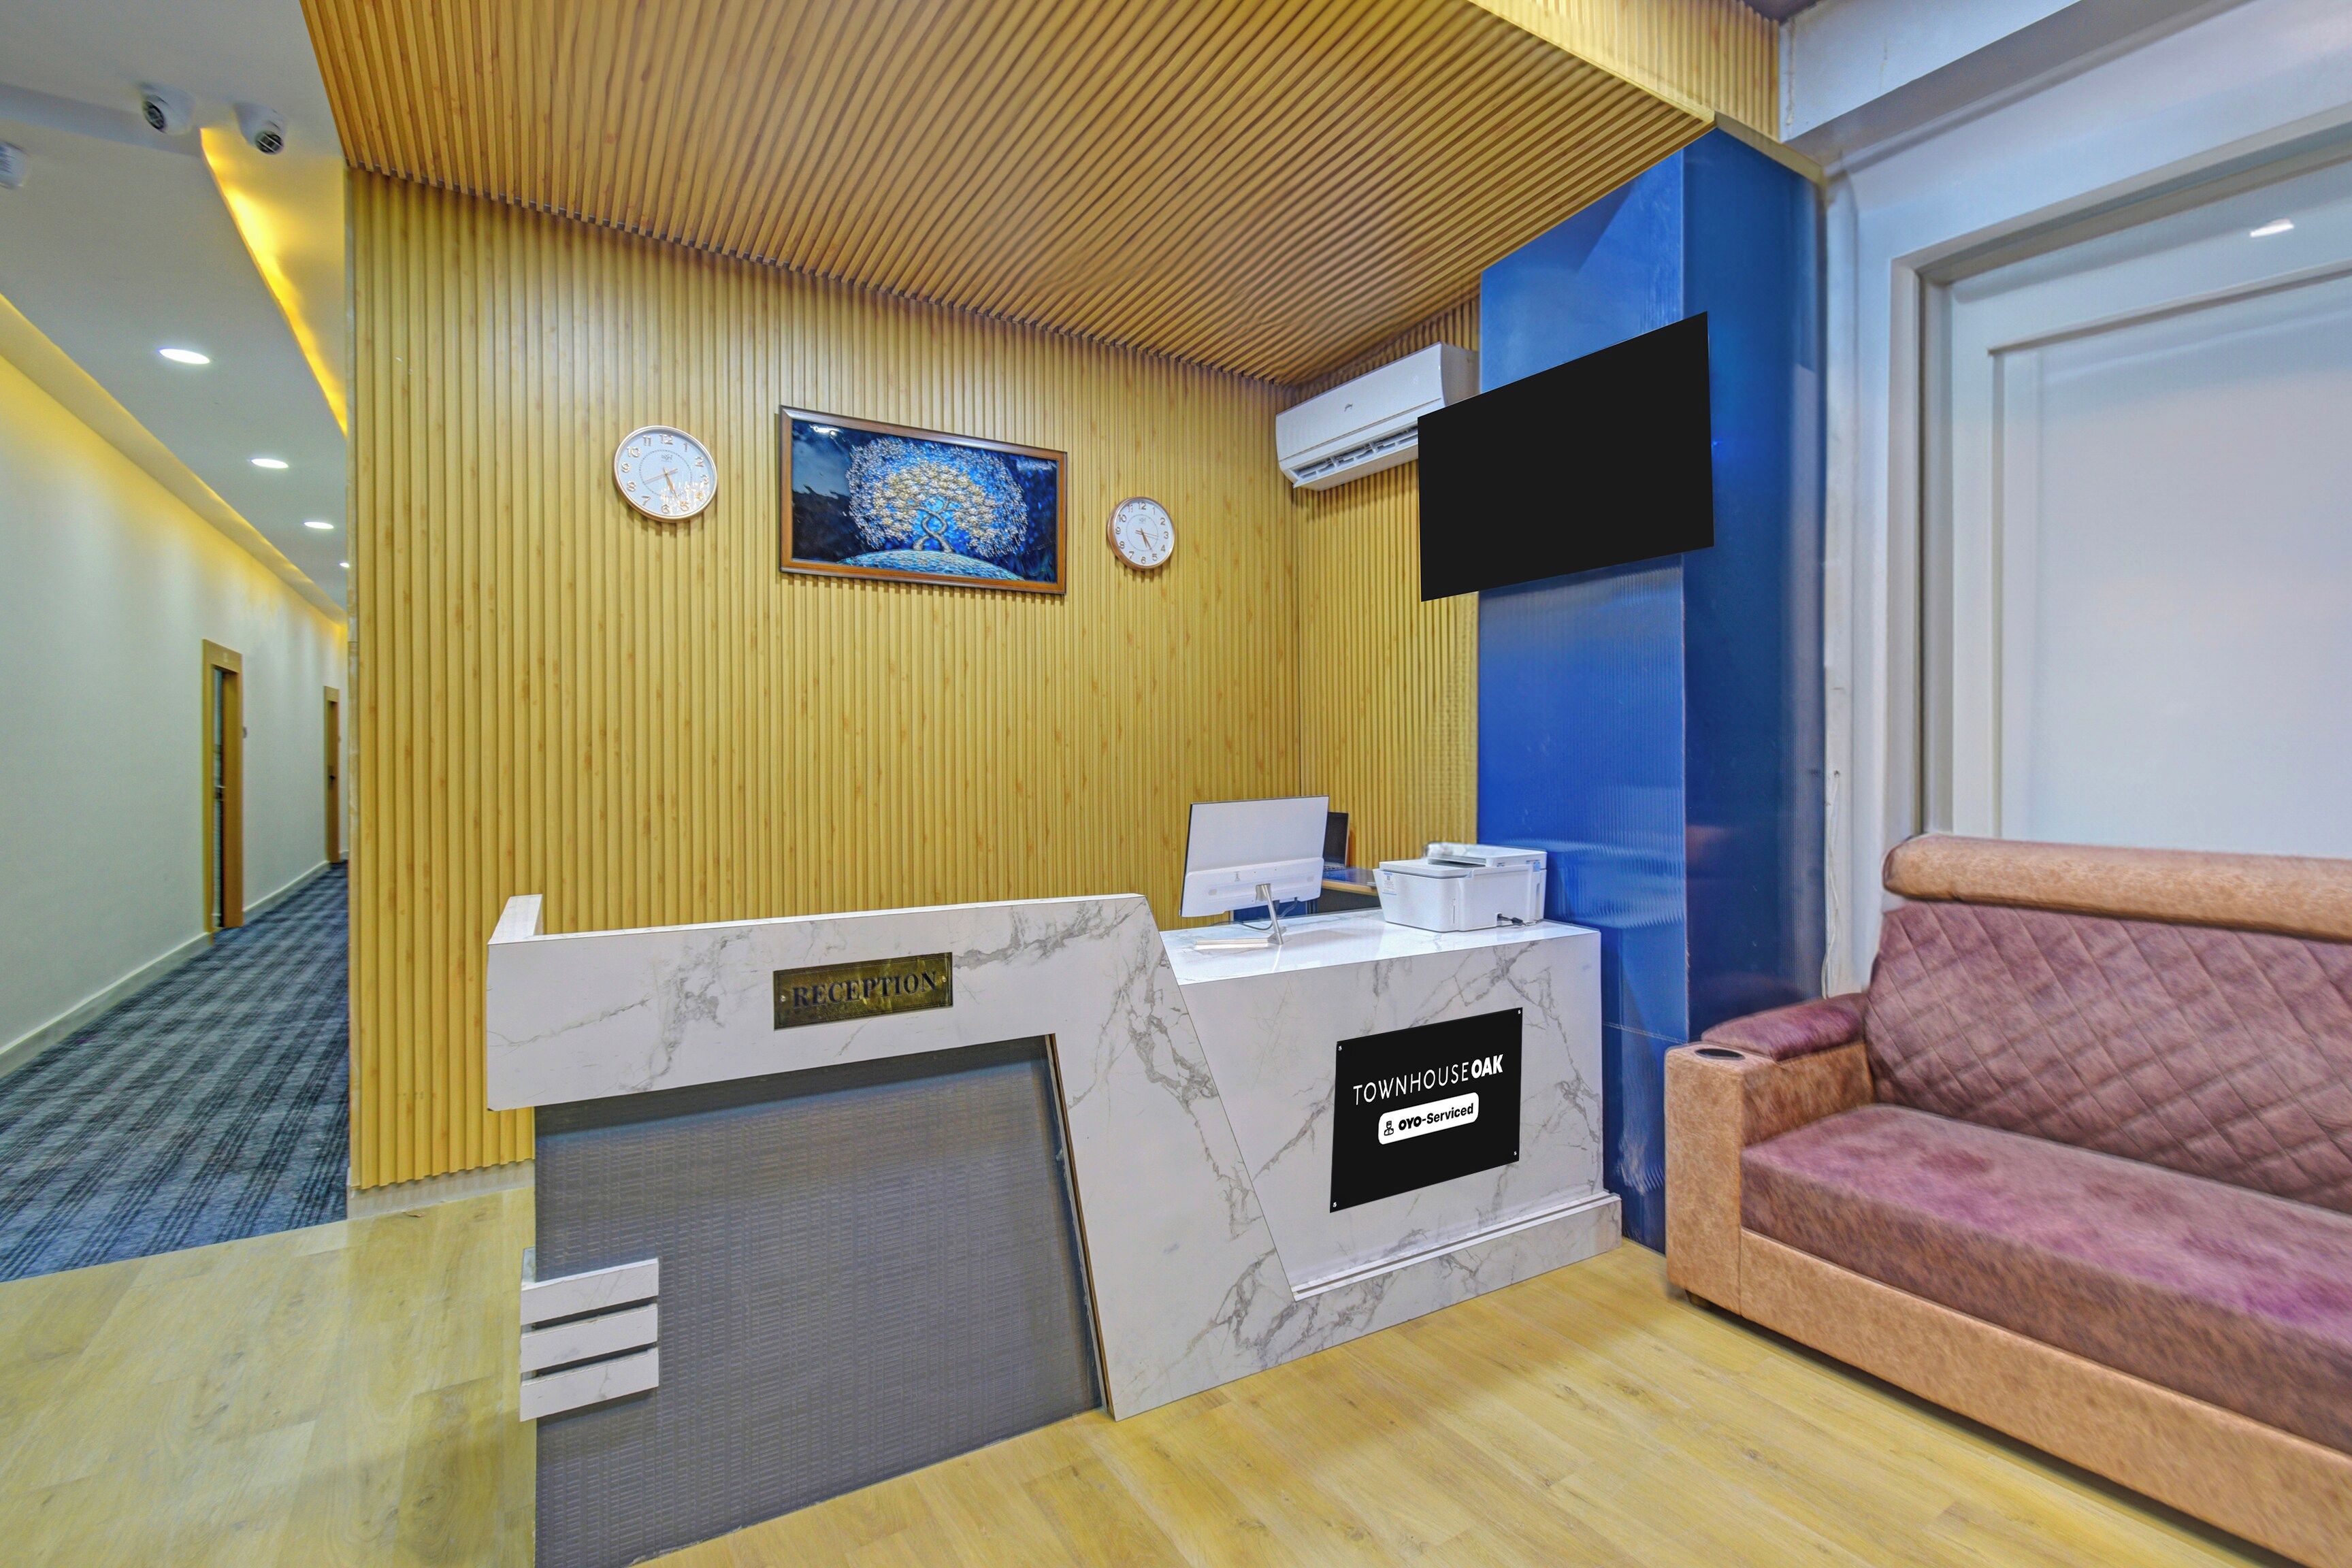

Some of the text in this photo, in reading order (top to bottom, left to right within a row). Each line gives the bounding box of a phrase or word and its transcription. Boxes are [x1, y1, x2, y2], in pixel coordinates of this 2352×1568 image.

[642, 435, 651, 446] 11
[659, 433, 673, 444] 12
[627, 446, 640, 457] 10
[621, 461, 630, 473] 9
[695, 456, 704, 468] 2
[700, 474, 709, 485] 3
[627, 480, 636, 492] 8
[642, 495, 651, 506] 7
[662, 504, 670, 514] 6
[680, 500, 689, 512] 5
[1127, 504, 1133, 512] 11
[1138, 502, 1146, 510] 12
[1118, 514, 1126, 523] 10
[1160, 517, 1166, 525] 2
[1115, 527, 1121, 535] 9
[1164, 531, 1169, 539] 3
[1119, 541, 1125, 549] 8
[1160, 544, 1166, 552] 4
[1129, 551, 1134, 559] 7
[1152, 553, 1158, 561] 5
[793, 970, 938, 1009] RECEPTION
[1399, 1102, 1473, 1131] OYO-Serviced
